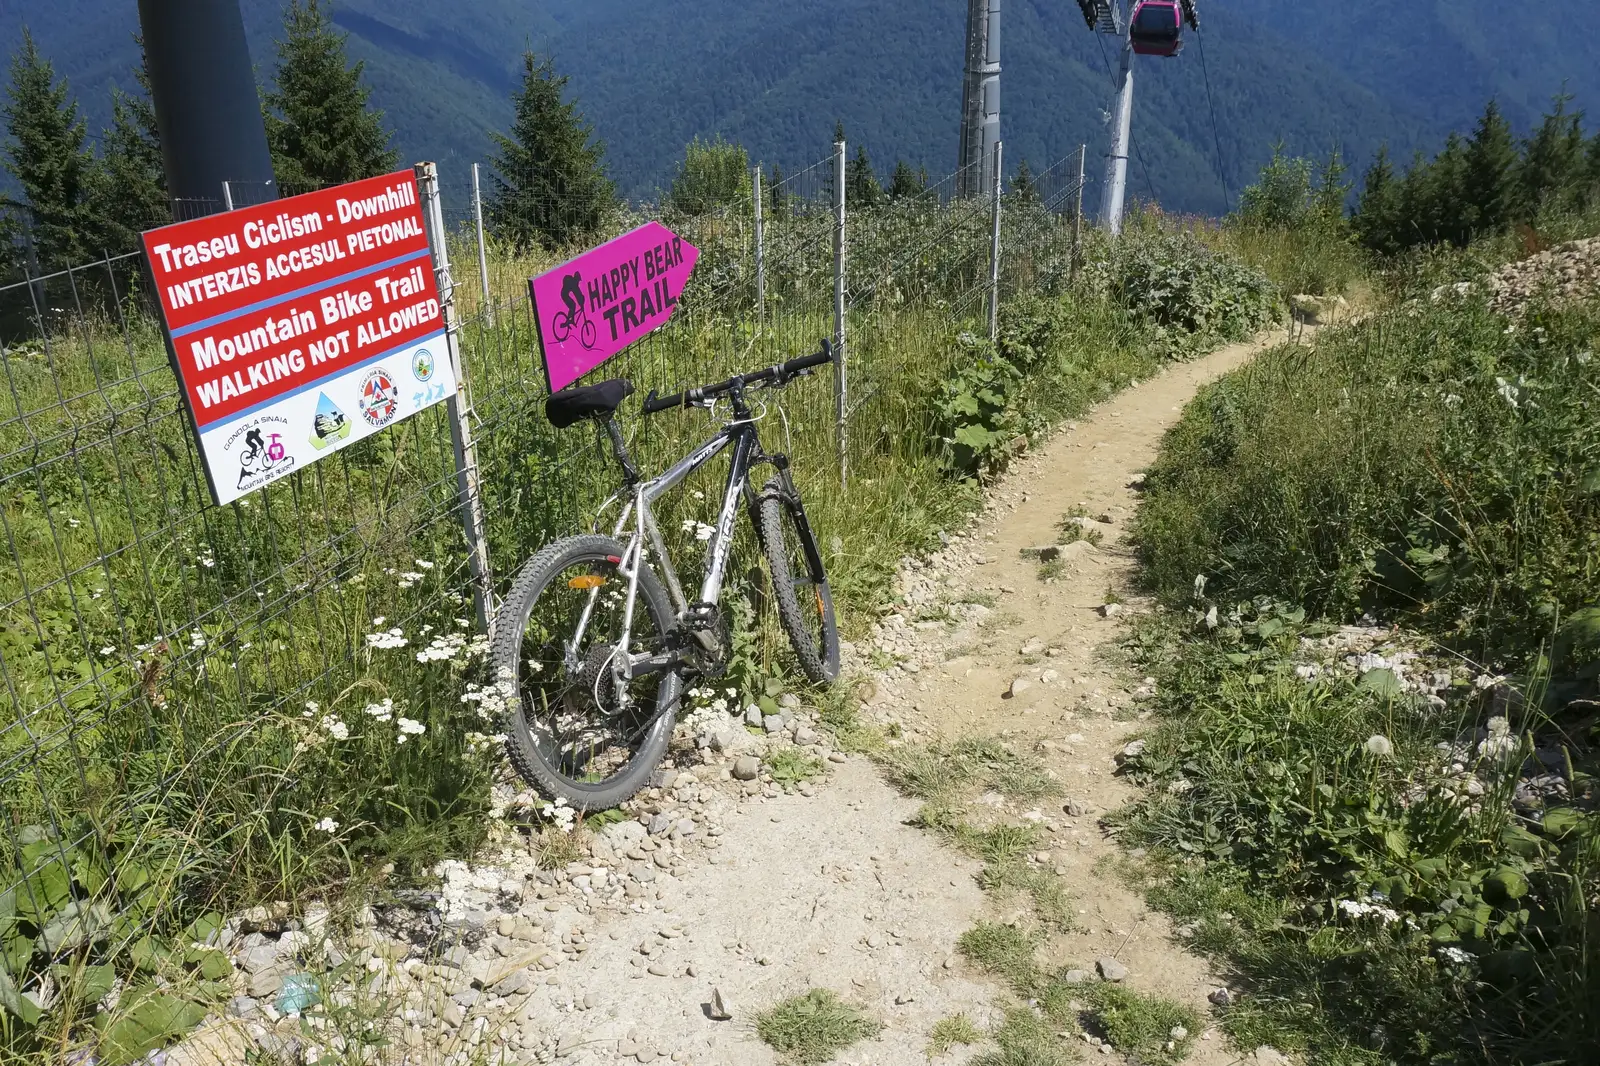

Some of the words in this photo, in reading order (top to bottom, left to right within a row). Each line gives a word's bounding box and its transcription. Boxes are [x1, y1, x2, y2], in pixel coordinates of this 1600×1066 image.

[153, 233, 240, 273] Traseu
[243, 211, 323, 249] Ciclism
[336, 181, 416, 225] Downhill
[167, 266, 262, 310] INTERZIS
[266, 239, 346, 280] ACCESUL
[346, 216, 423, 256] PIETONAL
[587, 256, 640, 313] HAPPY
[643, 236, 684, 282] BEAR
[603, 276, 678, 342] TRAIL
[190, 308, 317, 371] Mountain
[319, 289, 373, 326] Bike
[374, 266, 426, 304] Trail
[195, 349, 306, 409] WALKING
[308, 330, 351, 366] NOT
[357, 298, 440, 348] ALLOWED
[223, 419, 260, 451] GONDOLA
[260, 415, 288, 425] SINAIA
[362, 401, 398, 426] SALVAMONT
[714, 485, 740, 571] MERIDA
